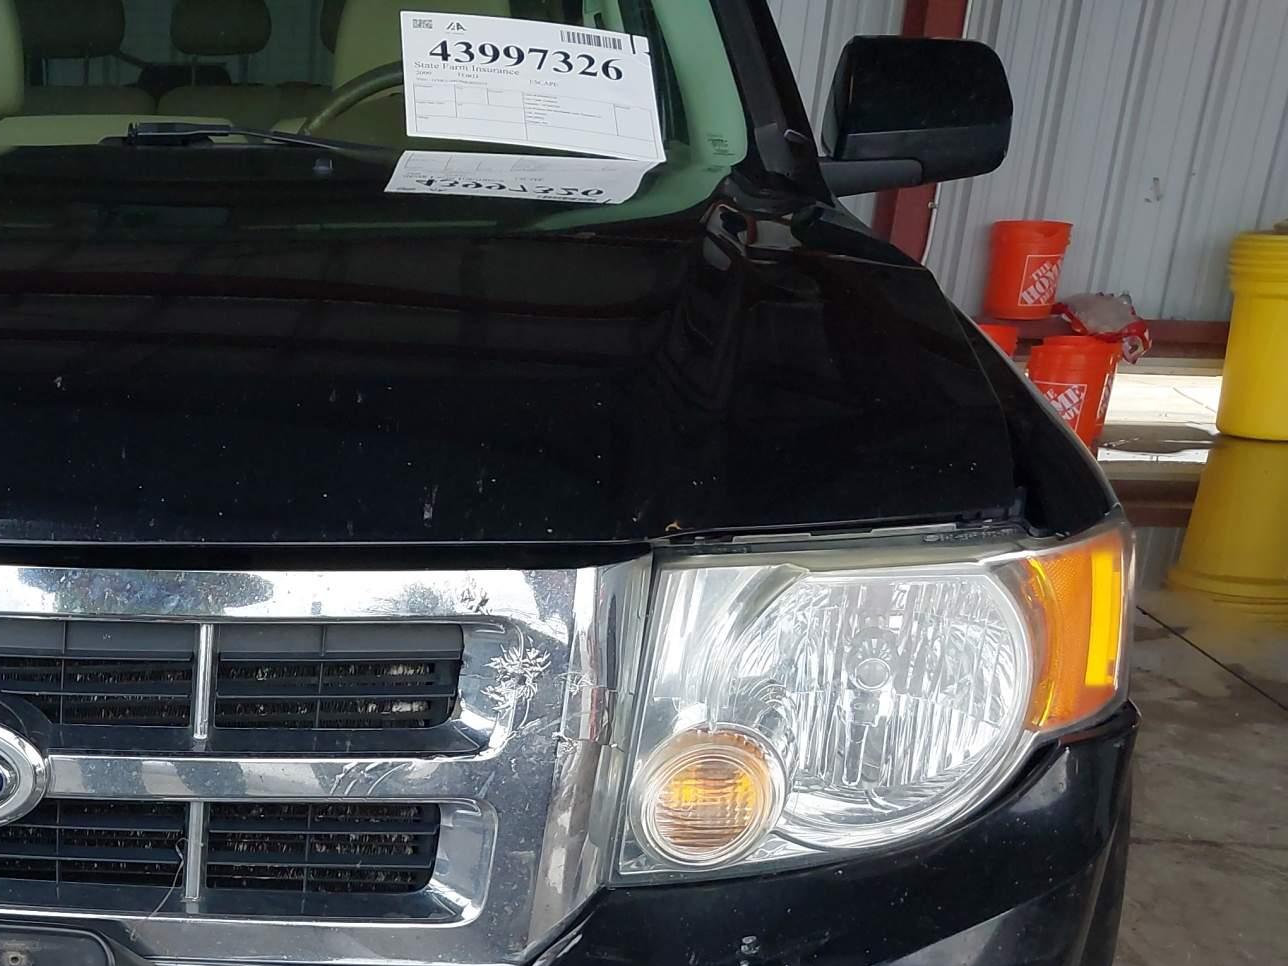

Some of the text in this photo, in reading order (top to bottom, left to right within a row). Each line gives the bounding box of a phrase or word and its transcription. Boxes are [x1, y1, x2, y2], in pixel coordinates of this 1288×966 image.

[414, 61, 440, 69] State
[442, 62, 468, 72] Farm
[472, 65, 520, 76] Insurance
[429, 40, 623, 80] 43997326
